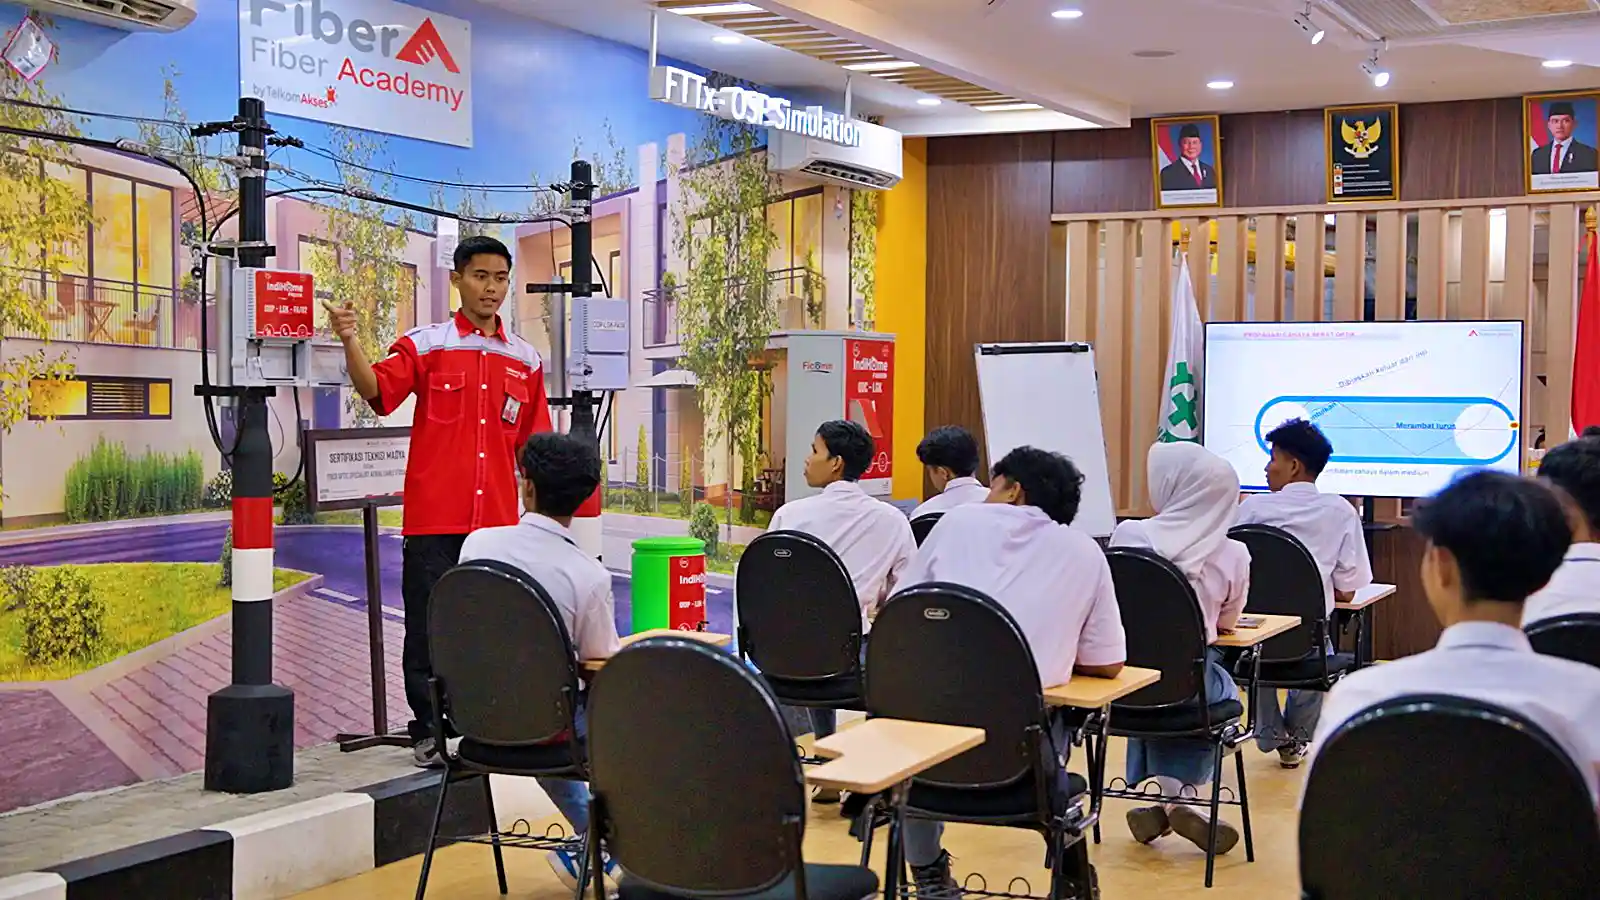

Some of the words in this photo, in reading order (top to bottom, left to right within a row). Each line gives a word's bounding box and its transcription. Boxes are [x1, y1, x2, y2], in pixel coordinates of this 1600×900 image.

[250, 0, 399, 57] Fiber
[251, 37, 328, 77] Fiber
[337, 58, 463, 111] Academy
[253, 84, 264, 97] by
[265, 86, 328, 108] TelkomAkses
[775, 99, 862, 147] Simulation
[266, 281, 303, 292] IndiHome
[853, 356, 888, 371] IndiHome
[329, 452, 363, 463] SERTIFIKASI
